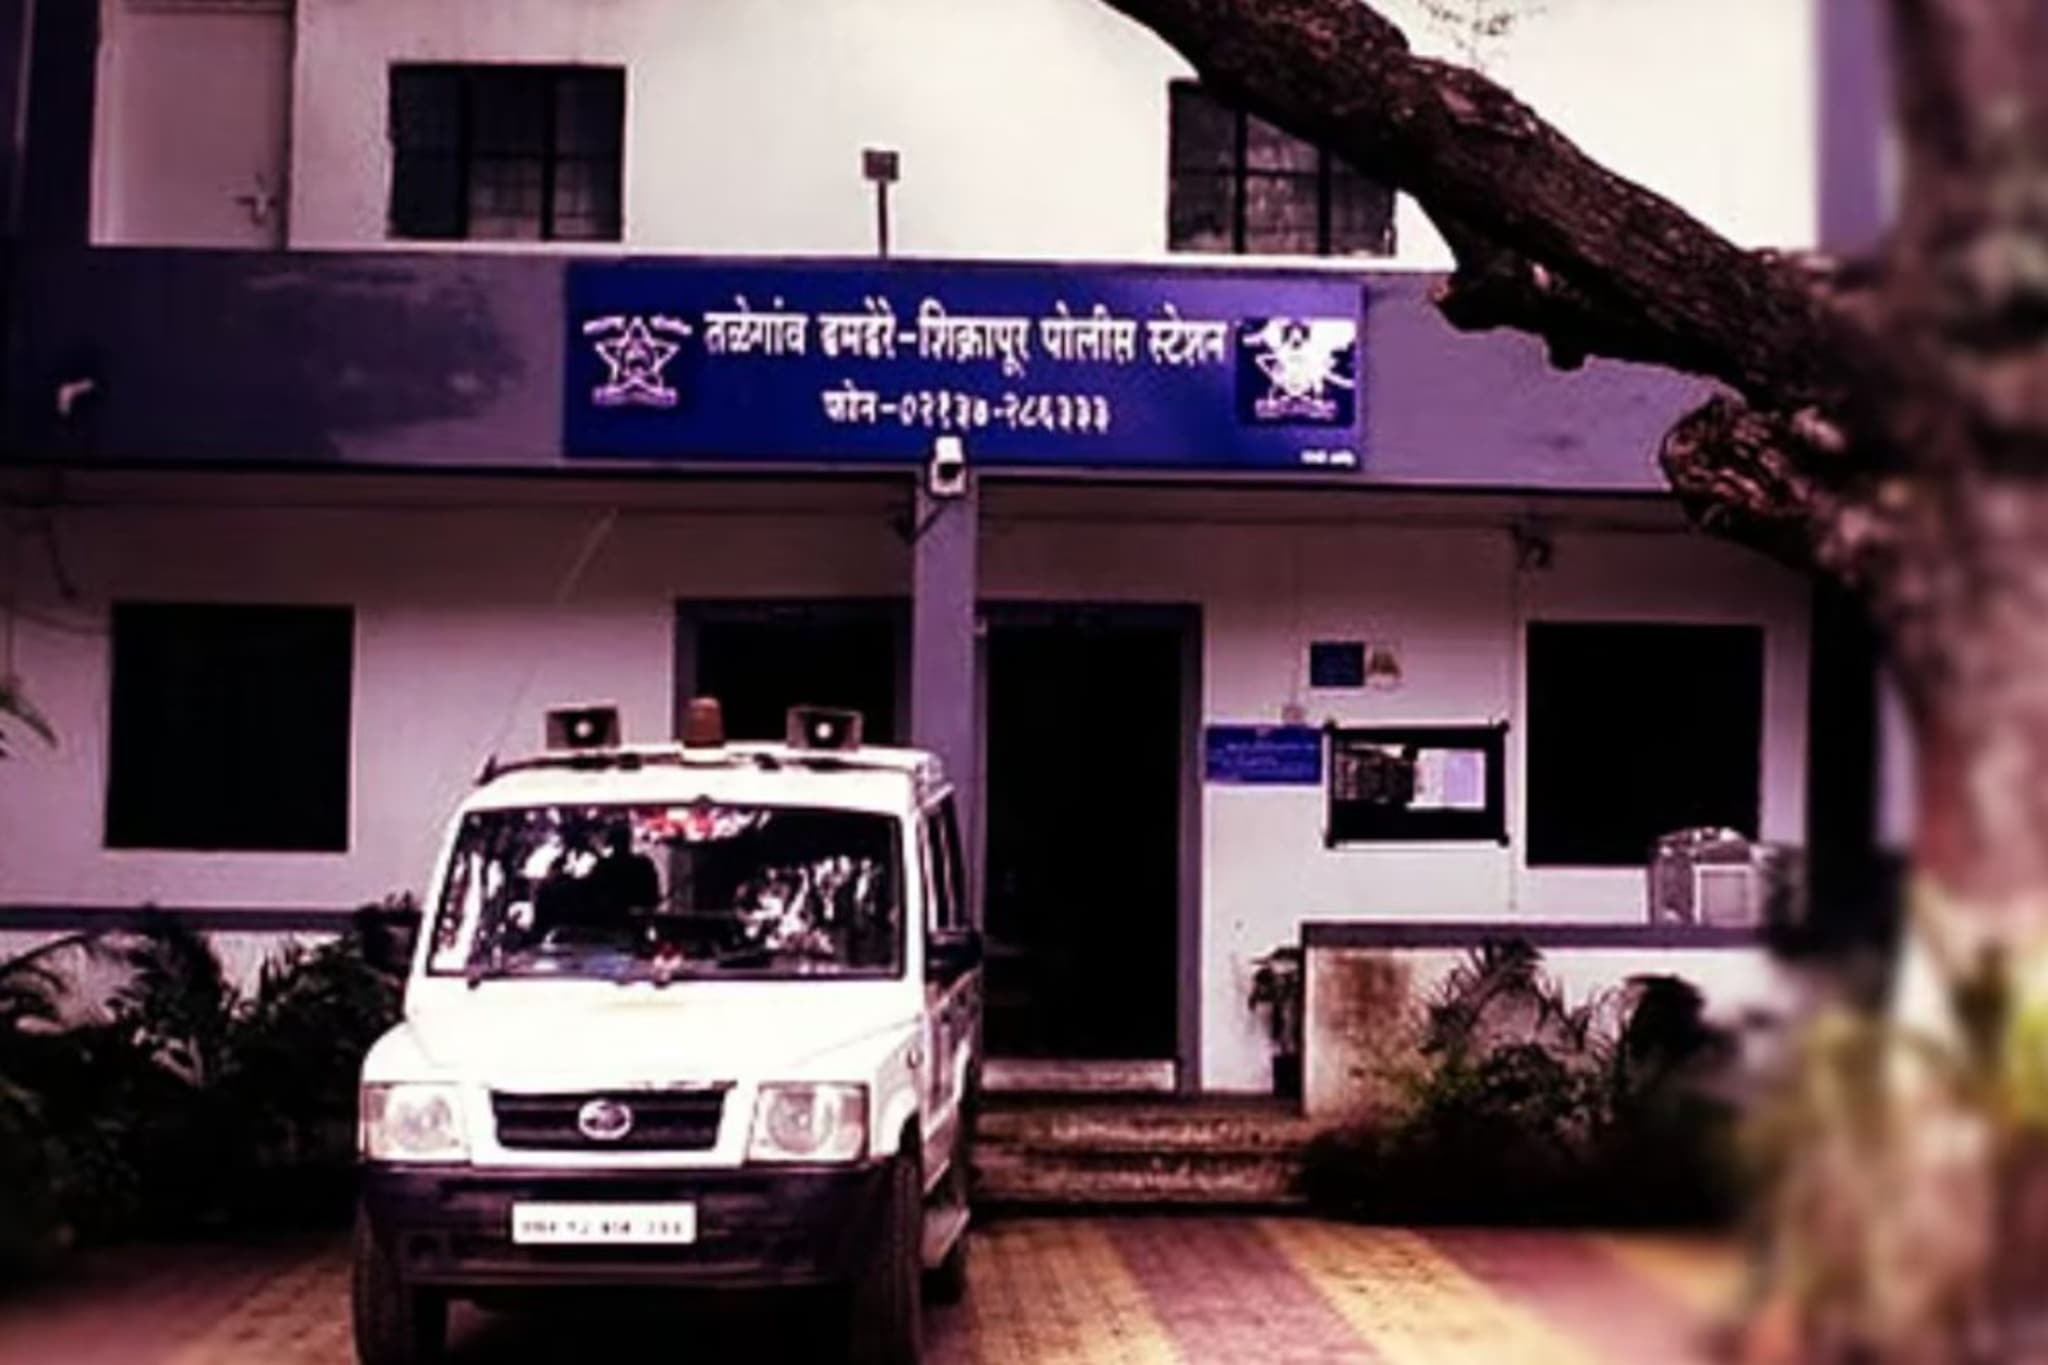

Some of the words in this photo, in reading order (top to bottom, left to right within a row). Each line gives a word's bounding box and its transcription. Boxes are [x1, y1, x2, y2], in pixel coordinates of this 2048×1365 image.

[702, 294, 808, 356] तळेगांव
[1039, 299, 1138, 364] पोलीस
[1146, 301, 1228, 366] स्टेशन
